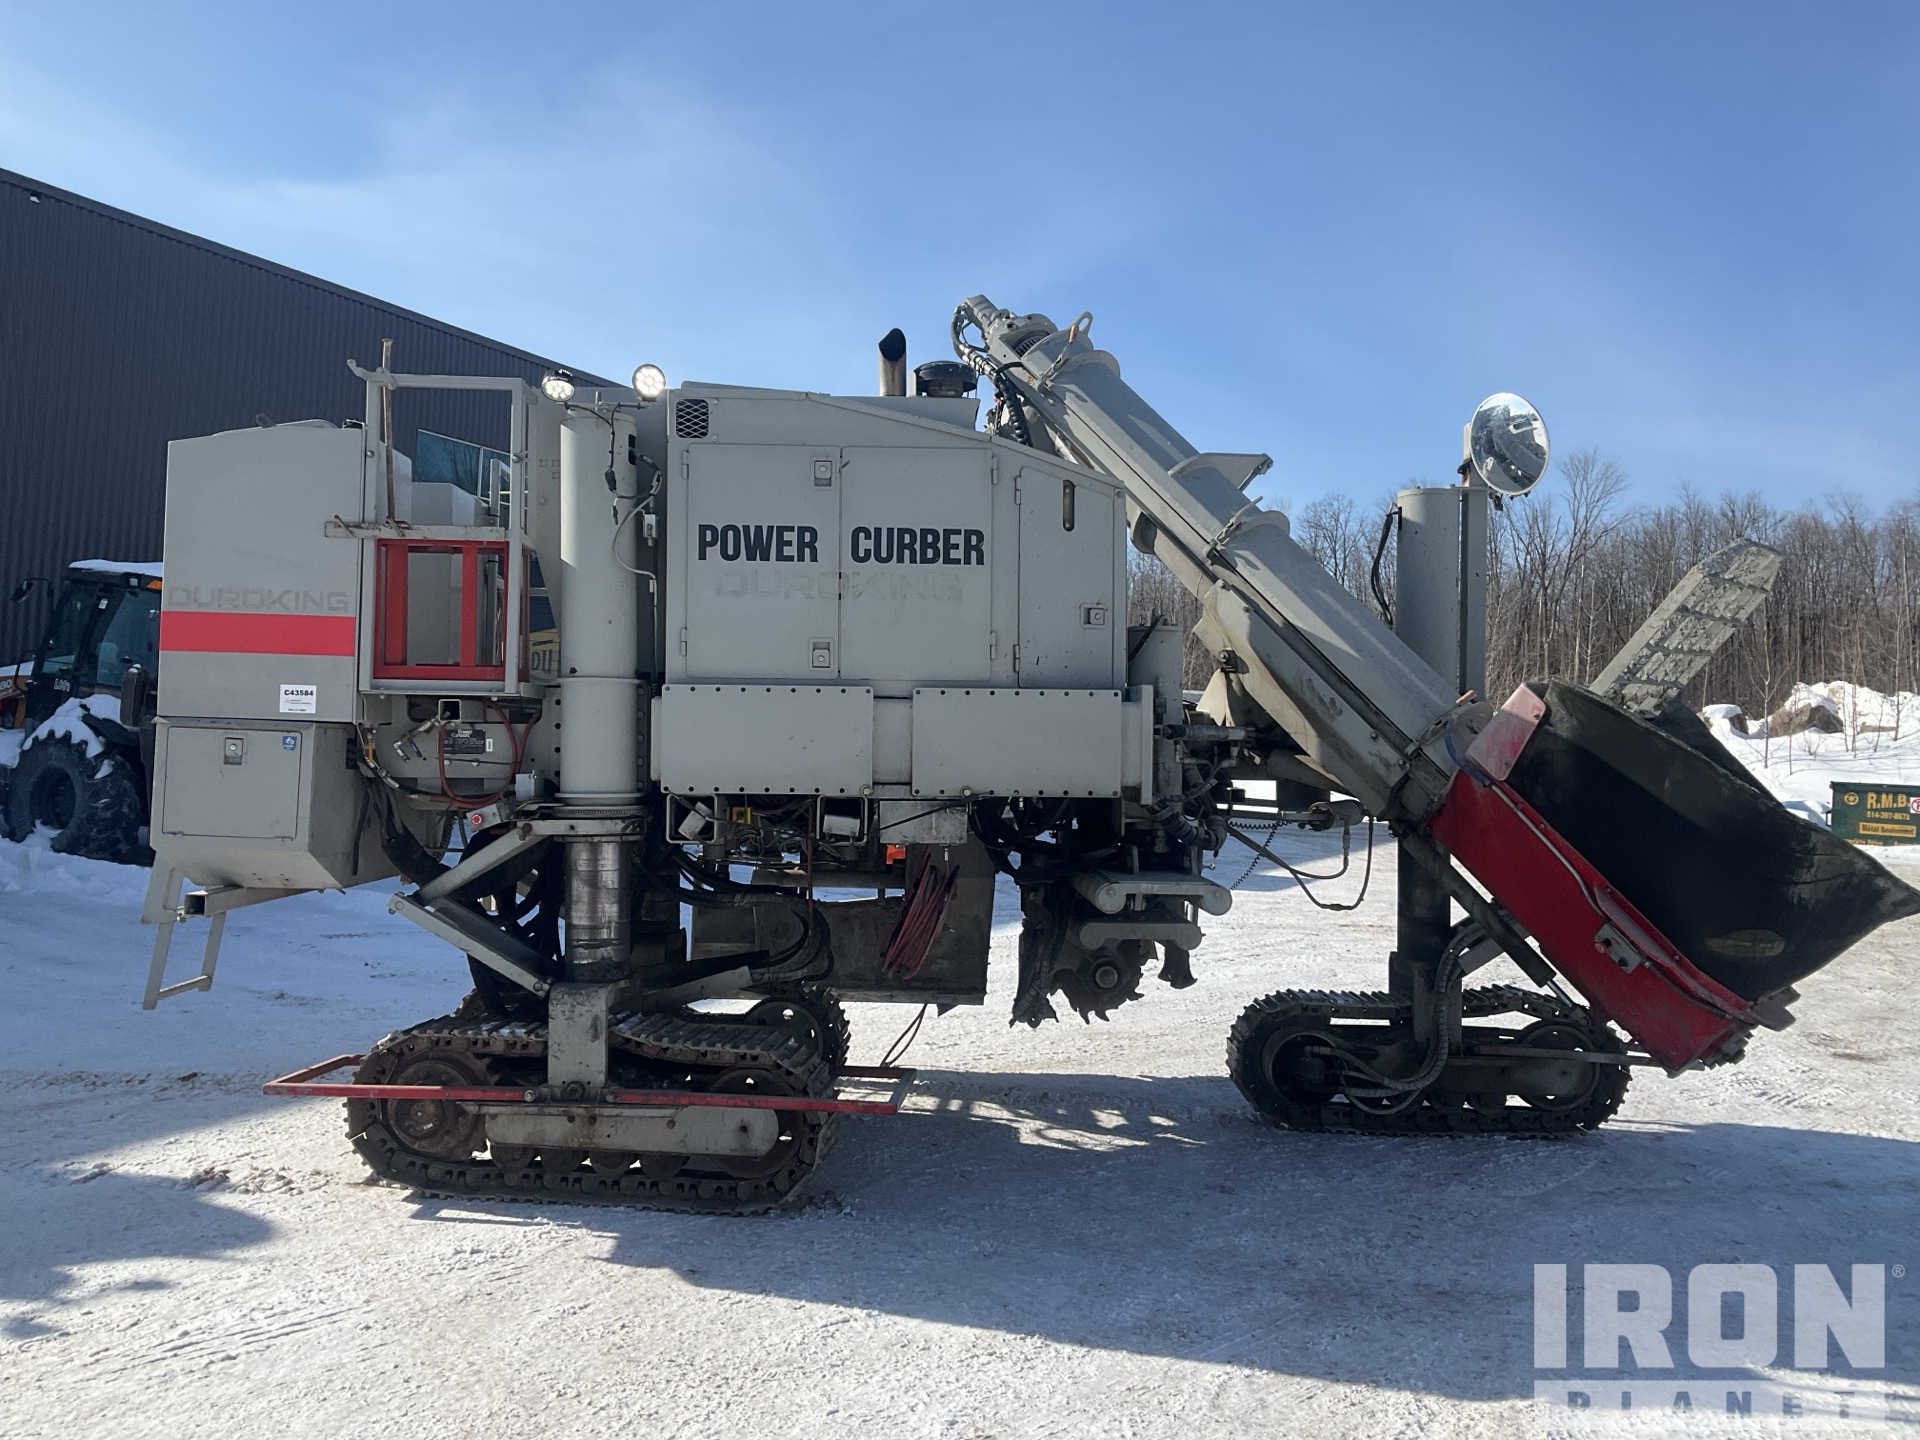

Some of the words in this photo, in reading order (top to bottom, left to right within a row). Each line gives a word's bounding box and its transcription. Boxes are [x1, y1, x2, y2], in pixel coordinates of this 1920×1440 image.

[698, 524, 818, 563] POWER
[850, 526, 985, 566] CURBER
[168, 586, 348, 612] DUROKING
